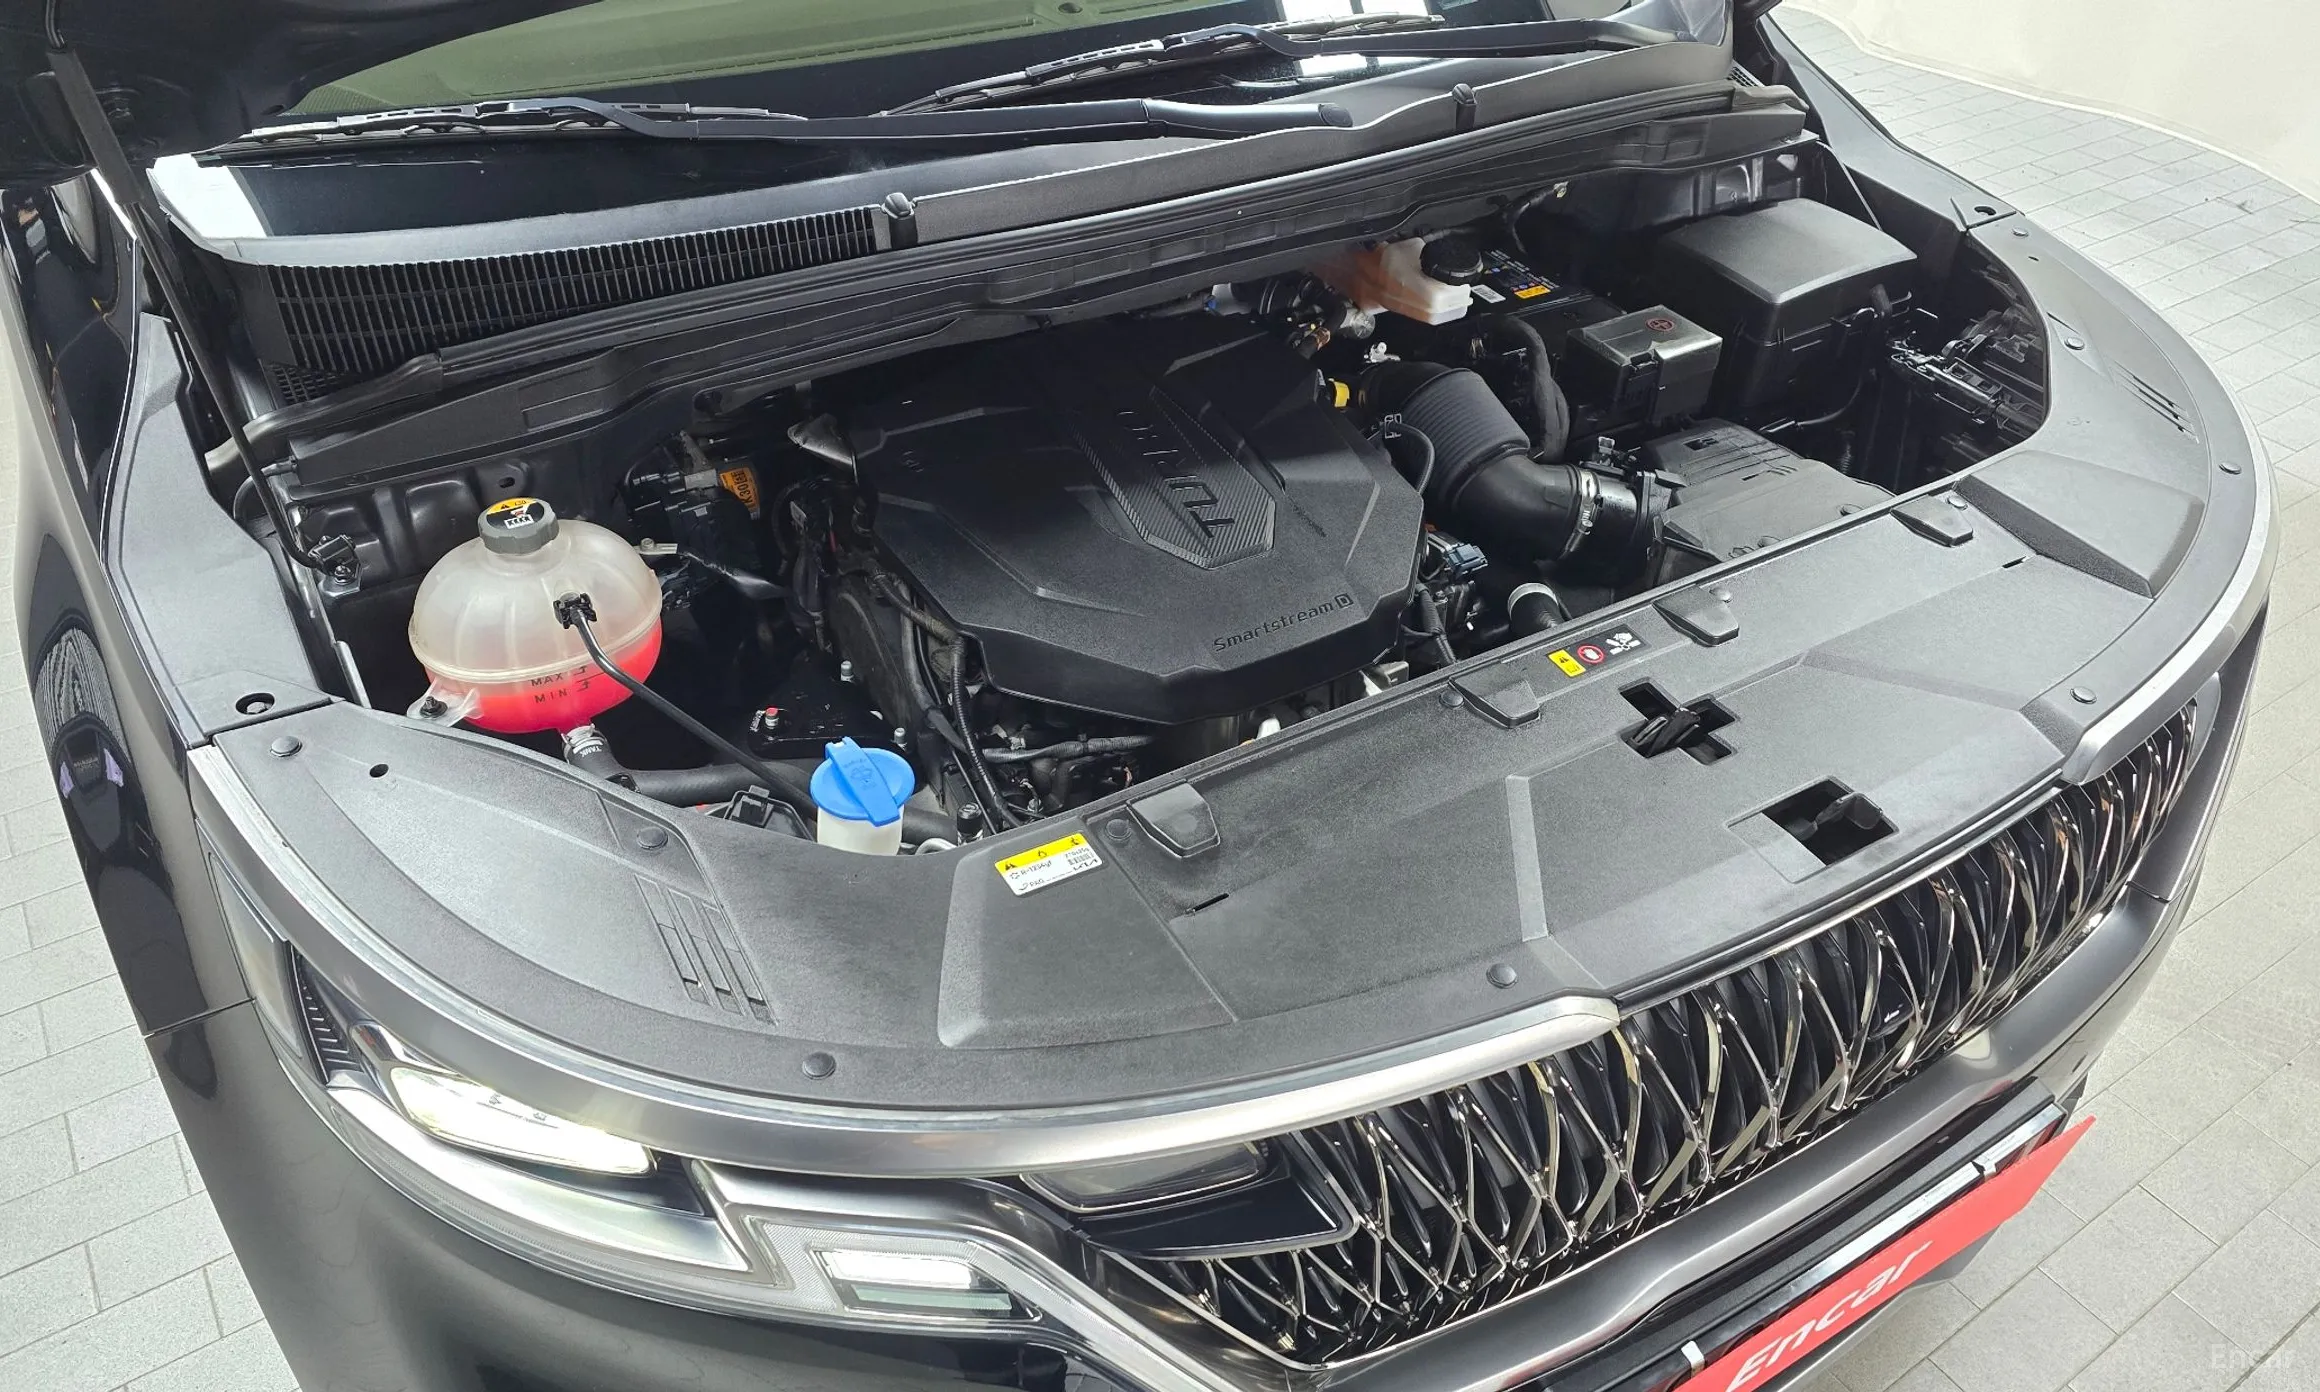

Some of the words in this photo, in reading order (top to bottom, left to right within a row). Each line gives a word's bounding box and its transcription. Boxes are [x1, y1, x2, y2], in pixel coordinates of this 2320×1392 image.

[1213, 601, 1334, 652] Smartstream
[1335, 592, 1355, 609] D
[530, 672, 563, 687] MAX
[534, 688, 568, 704] MIN
[1725, 1240, 1934, 1392] Encar
